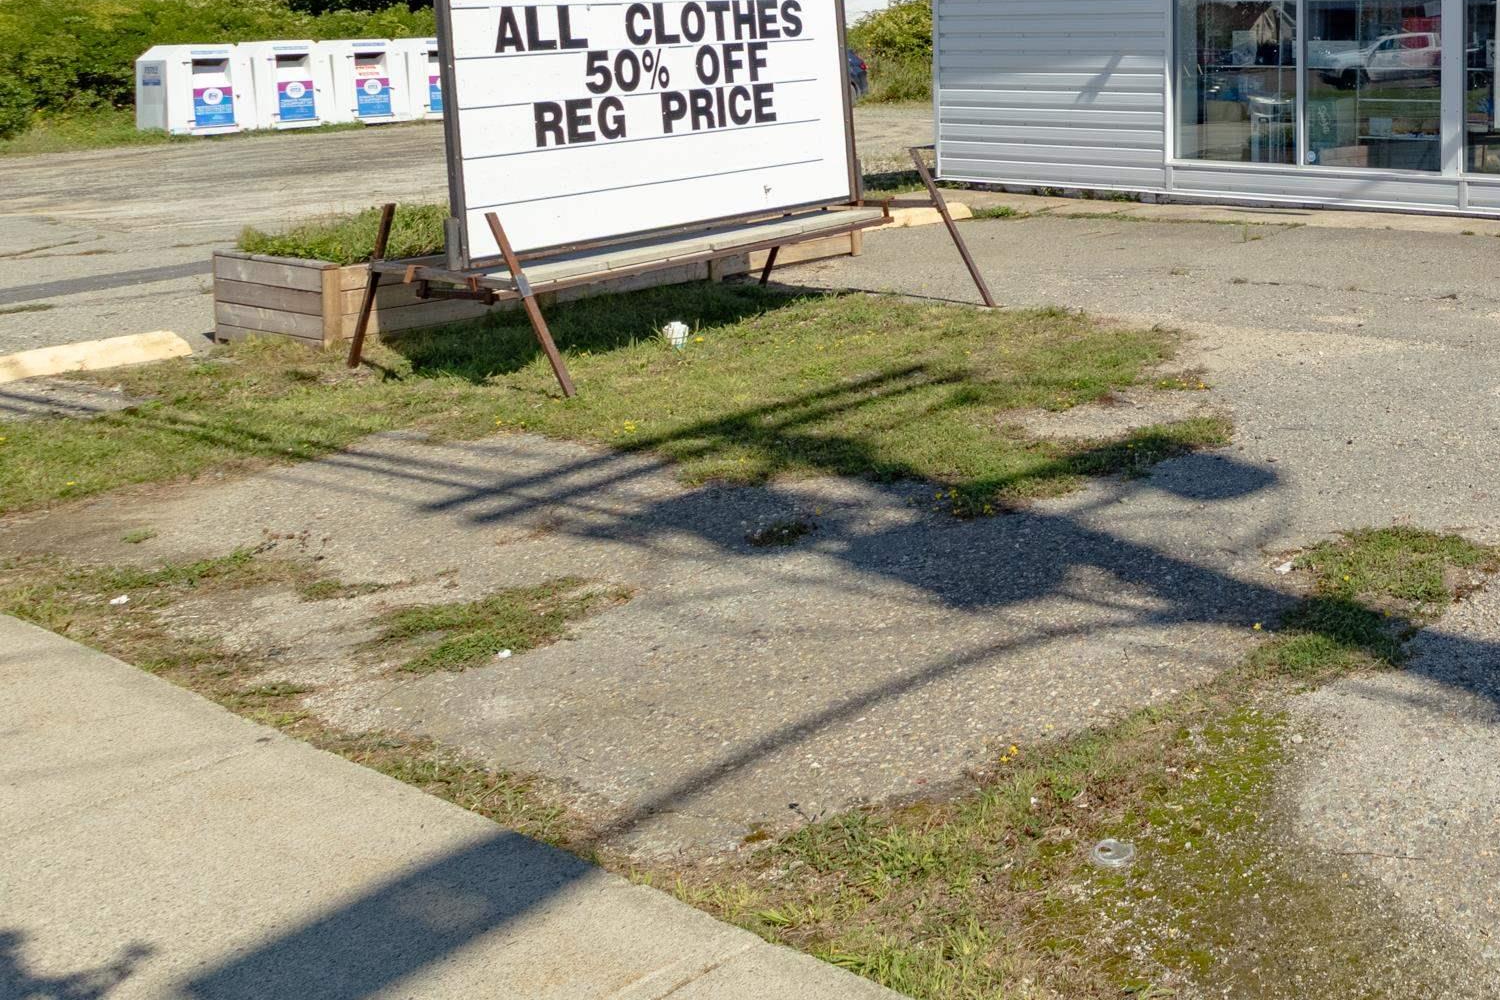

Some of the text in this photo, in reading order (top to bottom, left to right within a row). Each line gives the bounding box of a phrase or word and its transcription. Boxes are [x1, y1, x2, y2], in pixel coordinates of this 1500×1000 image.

[495, 0, 803, 53] ALL CLOTHES
[585, 42, 769, 94] 50% OFF
[533, 83, 777, 147] REG PRICE
